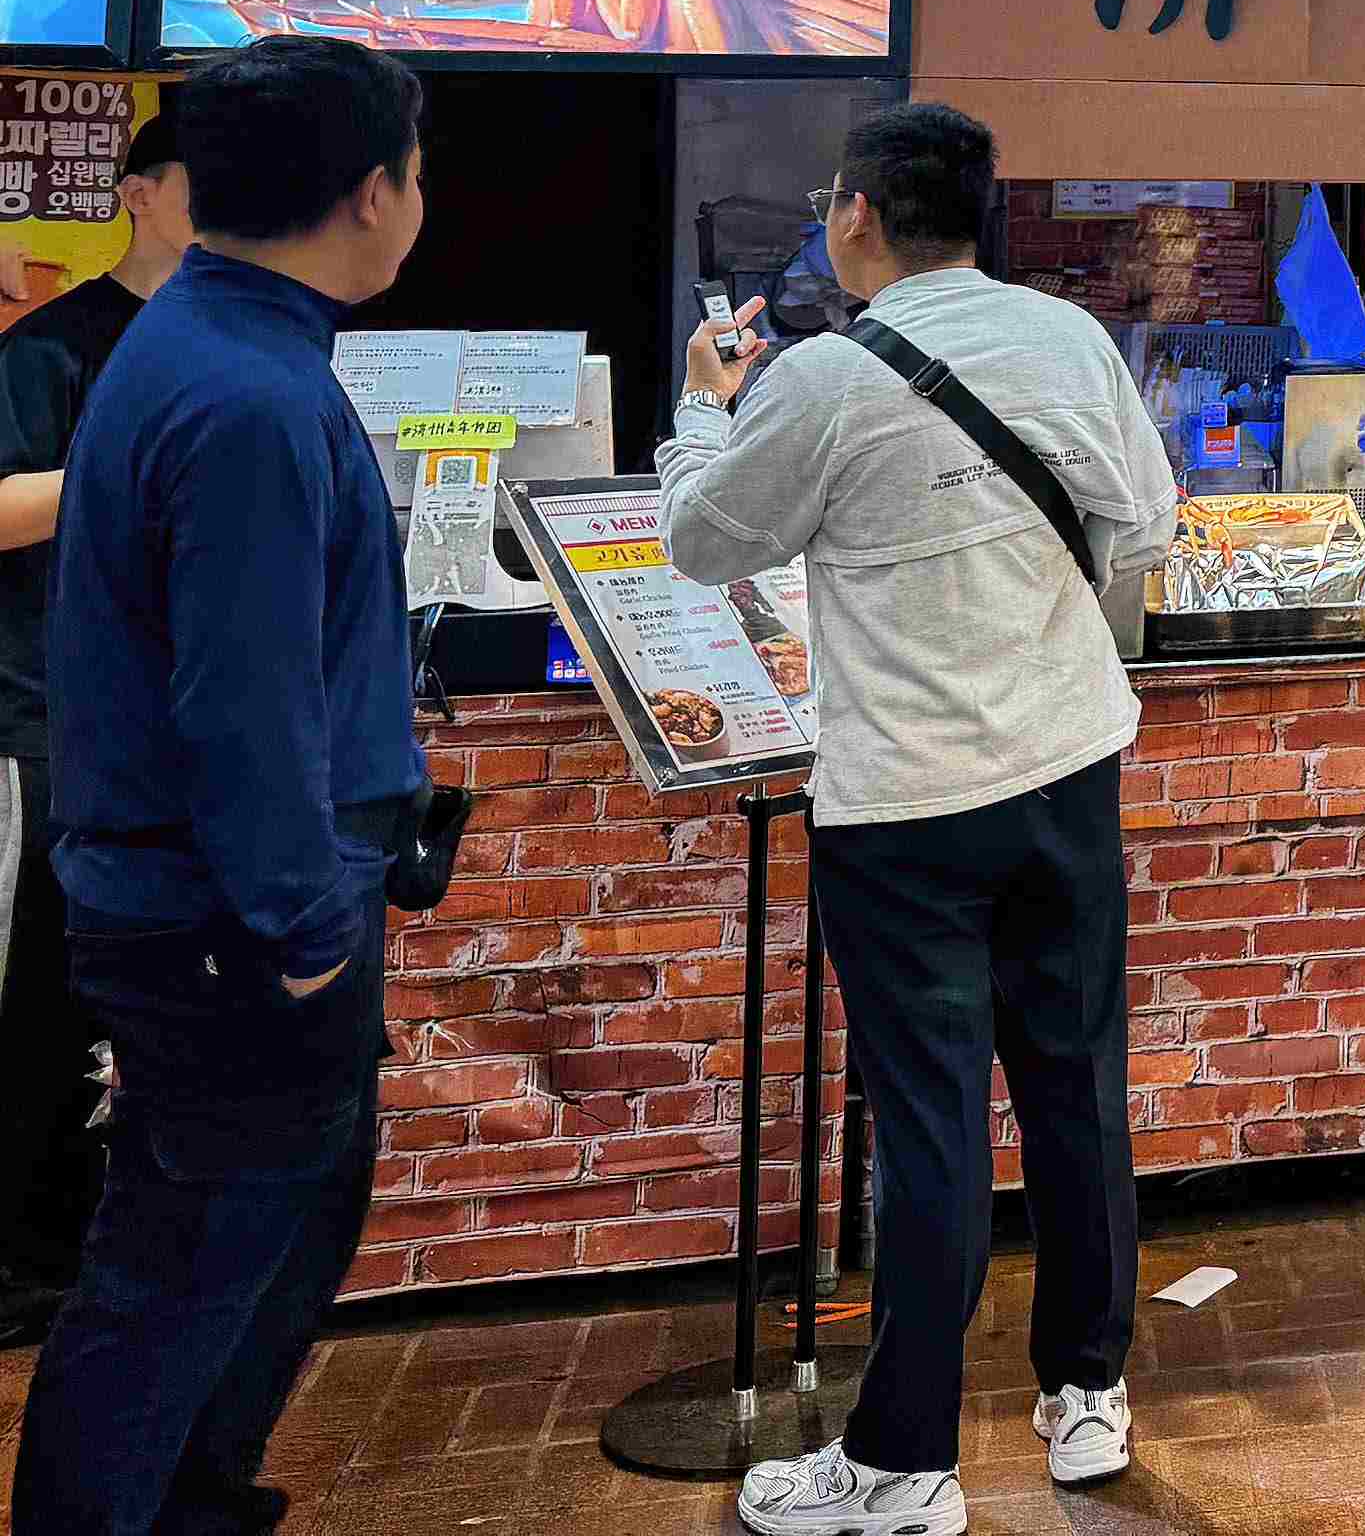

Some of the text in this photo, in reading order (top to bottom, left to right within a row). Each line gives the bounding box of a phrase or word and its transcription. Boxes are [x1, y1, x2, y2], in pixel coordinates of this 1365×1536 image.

[15, 80, 128, 117] 100%
[0, 119, 122, 158] 짜렐라
[609, 516, 658, 532] MEN
